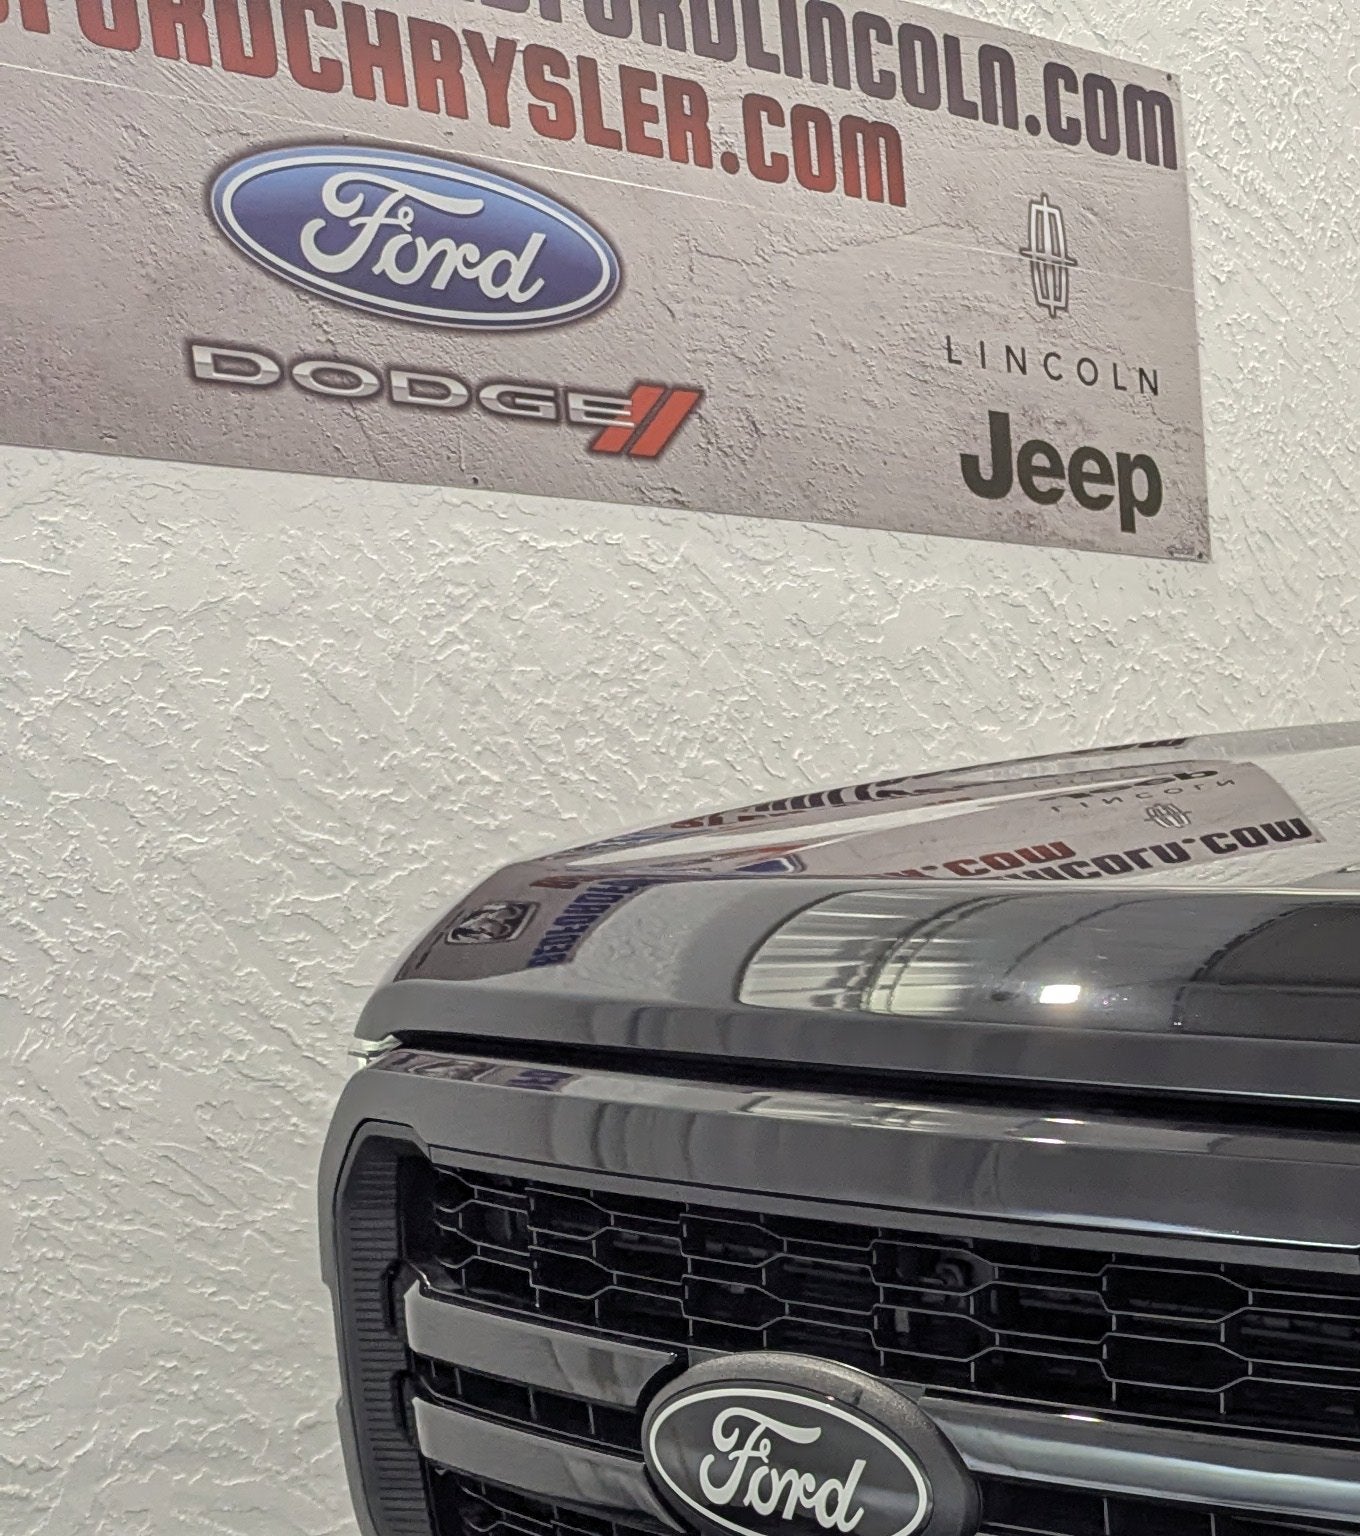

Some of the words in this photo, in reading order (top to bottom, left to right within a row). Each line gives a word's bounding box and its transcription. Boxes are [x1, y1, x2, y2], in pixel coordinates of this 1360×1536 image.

[0, 0, 906, 207] RDCHRYSLER.COM
[480, 0, 1178, 170] RDLINCOLN.COM
[300, 171, 547, 303] Ford
[191, 344, 635, 429] DODGE
[946, 335, 1159, 396] LINCOLN
[960, 410, 1163, 533] Jeep
[700, 1406, 867, 1533] Ford
